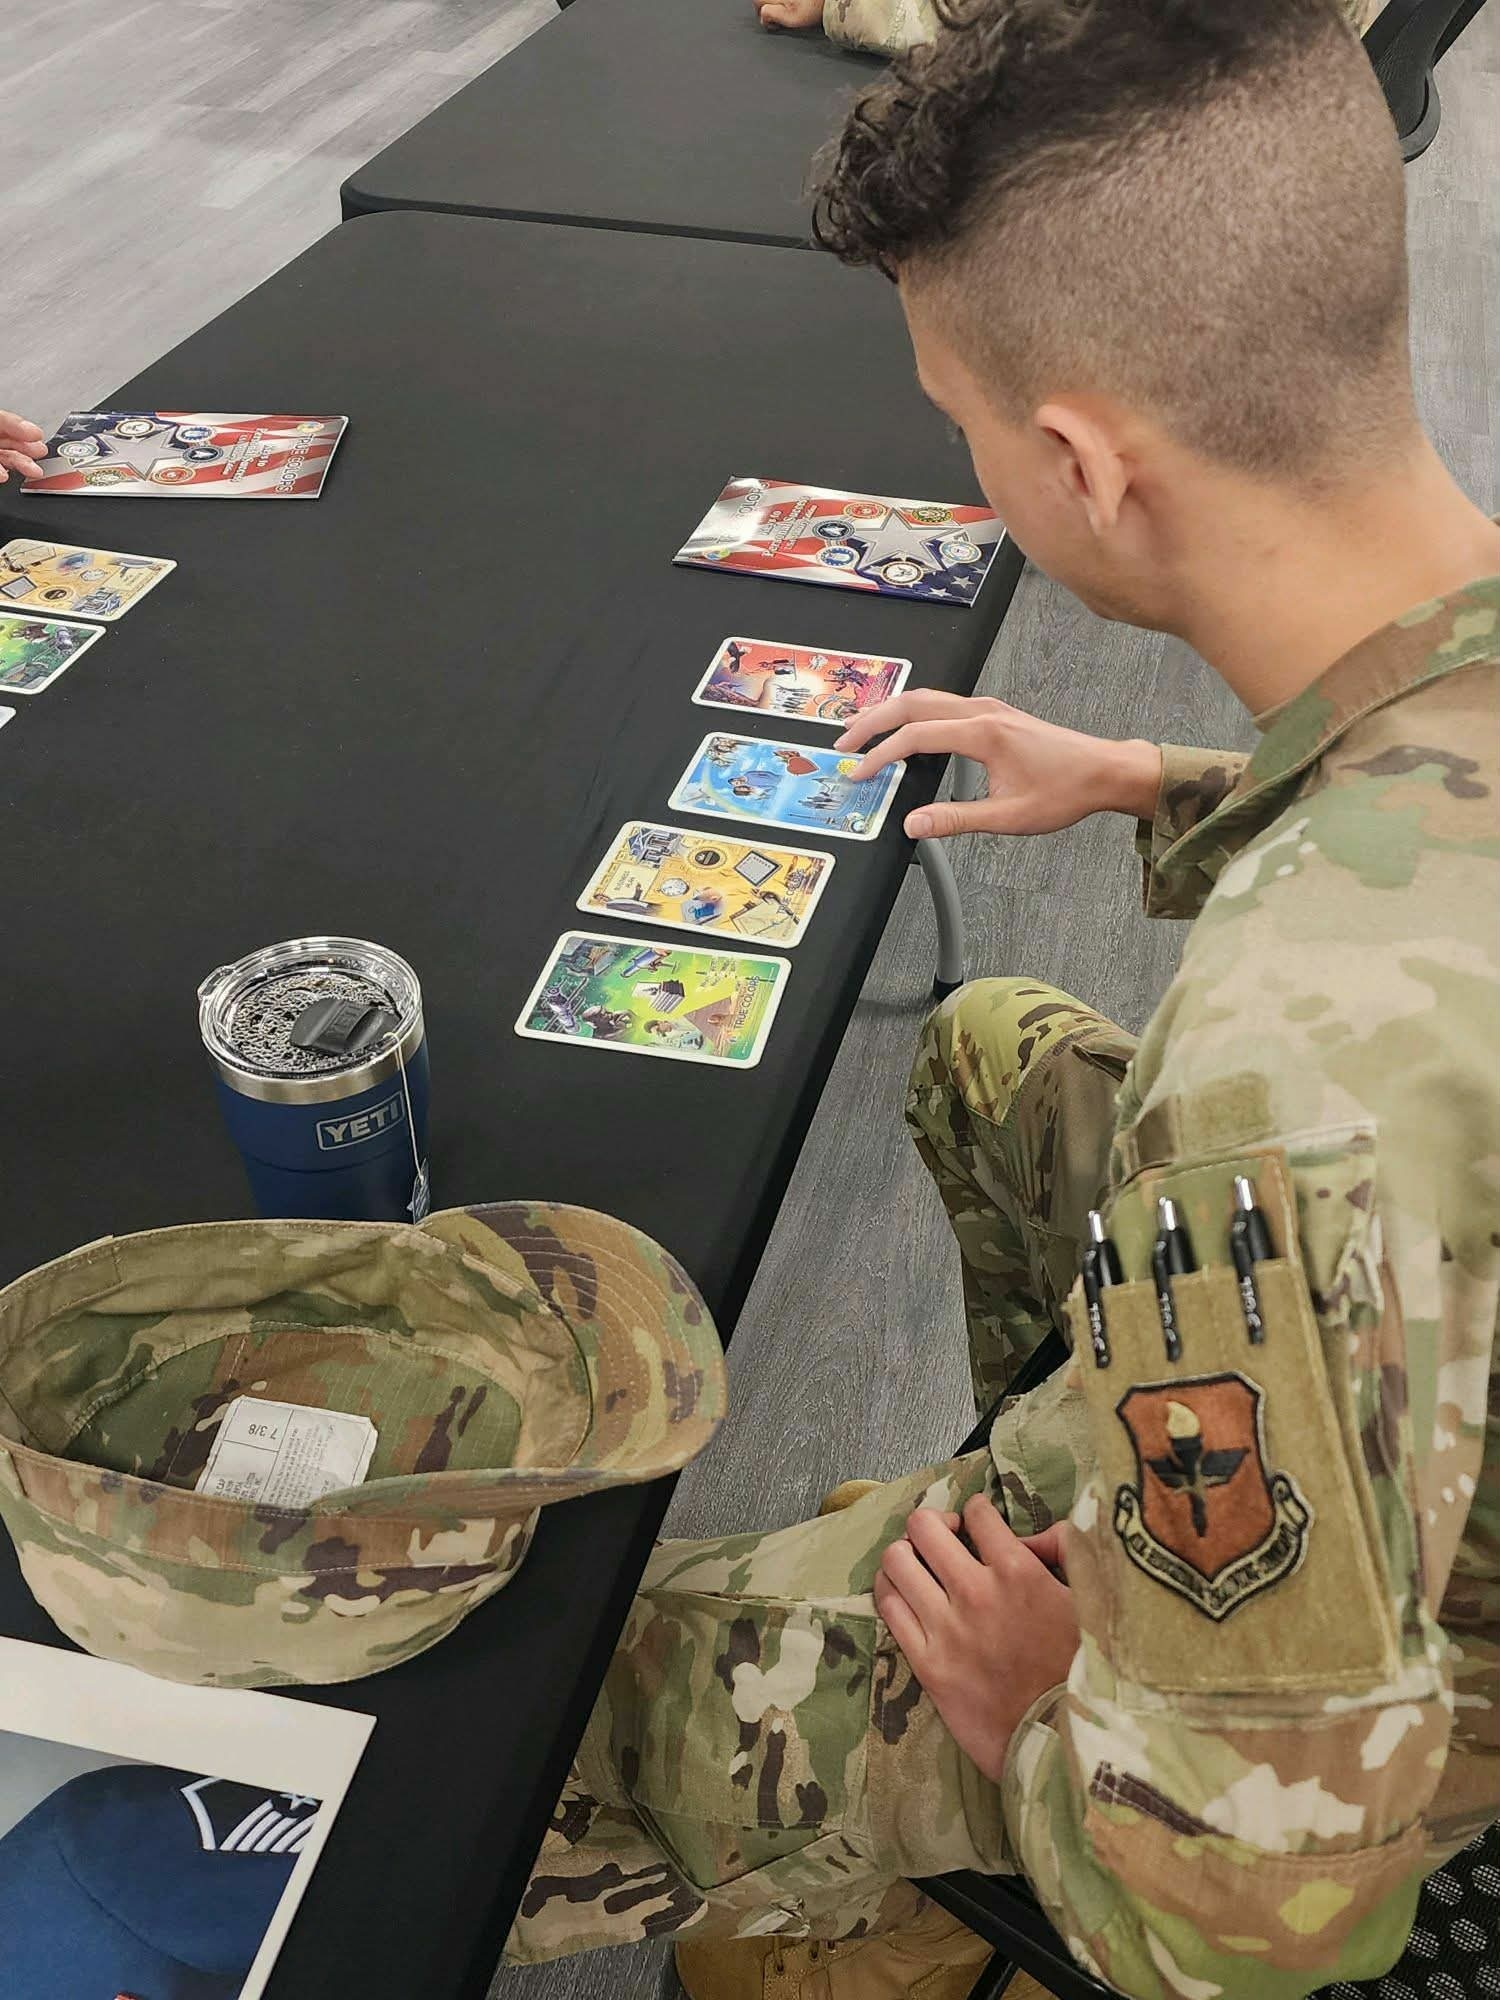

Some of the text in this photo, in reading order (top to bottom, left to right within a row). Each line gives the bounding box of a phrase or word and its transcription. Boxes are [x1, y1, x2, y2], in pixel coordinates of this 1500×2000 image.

[275, 433, 315, 492] TRUE COLORS
[760, 523, 794, 558] Personal
[733, 1009, 748, 1029] TRUE
[742, 975, 761, 1008] COLORS
[324, 1102, 399, 1142] YETI
[248, 1423, 279, 1440] 7 3/8
